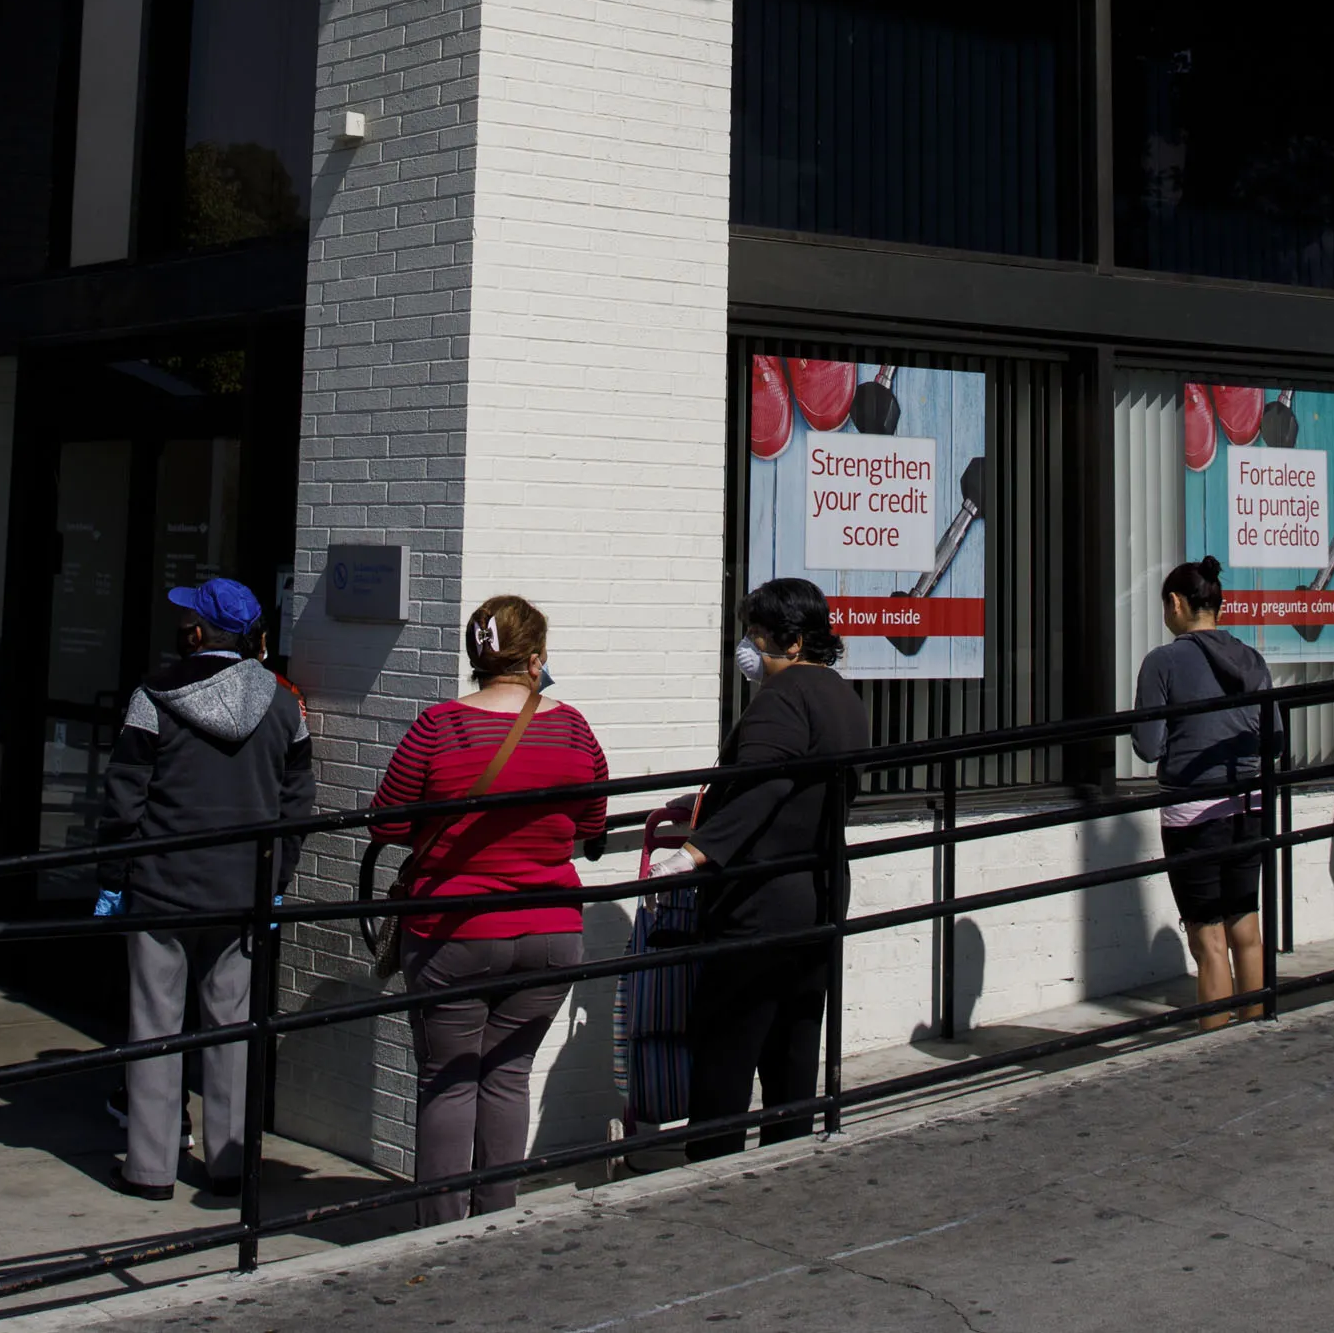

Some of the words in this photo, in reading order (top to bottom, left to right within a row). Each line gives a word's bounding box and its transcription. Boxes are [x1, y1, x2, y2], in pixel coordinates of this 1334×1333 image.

[811, 448, 931, 486] Strengthen
[1240, 461, 1316, 487] Fortalece
[812, 490, 861, 518] your
[868, 487, 928, 514] credit
[1236, 494, 1253, 515] tu
[1259, 495, 1320, 523] puntaje
[842, 526, 899, 547] score
[1237, 521, 1258, 546] de
[1264, 523, 1320, 547] crédito
[828, 608, 845, 625] sk
[848, 608, 877, 625] how
[882, 609, 921, 625] inside
[1220, 599, 1249, 615] Entra
[1251, 602, 1259, 617] y
[1261, 599, 1308, 617] pregunta
